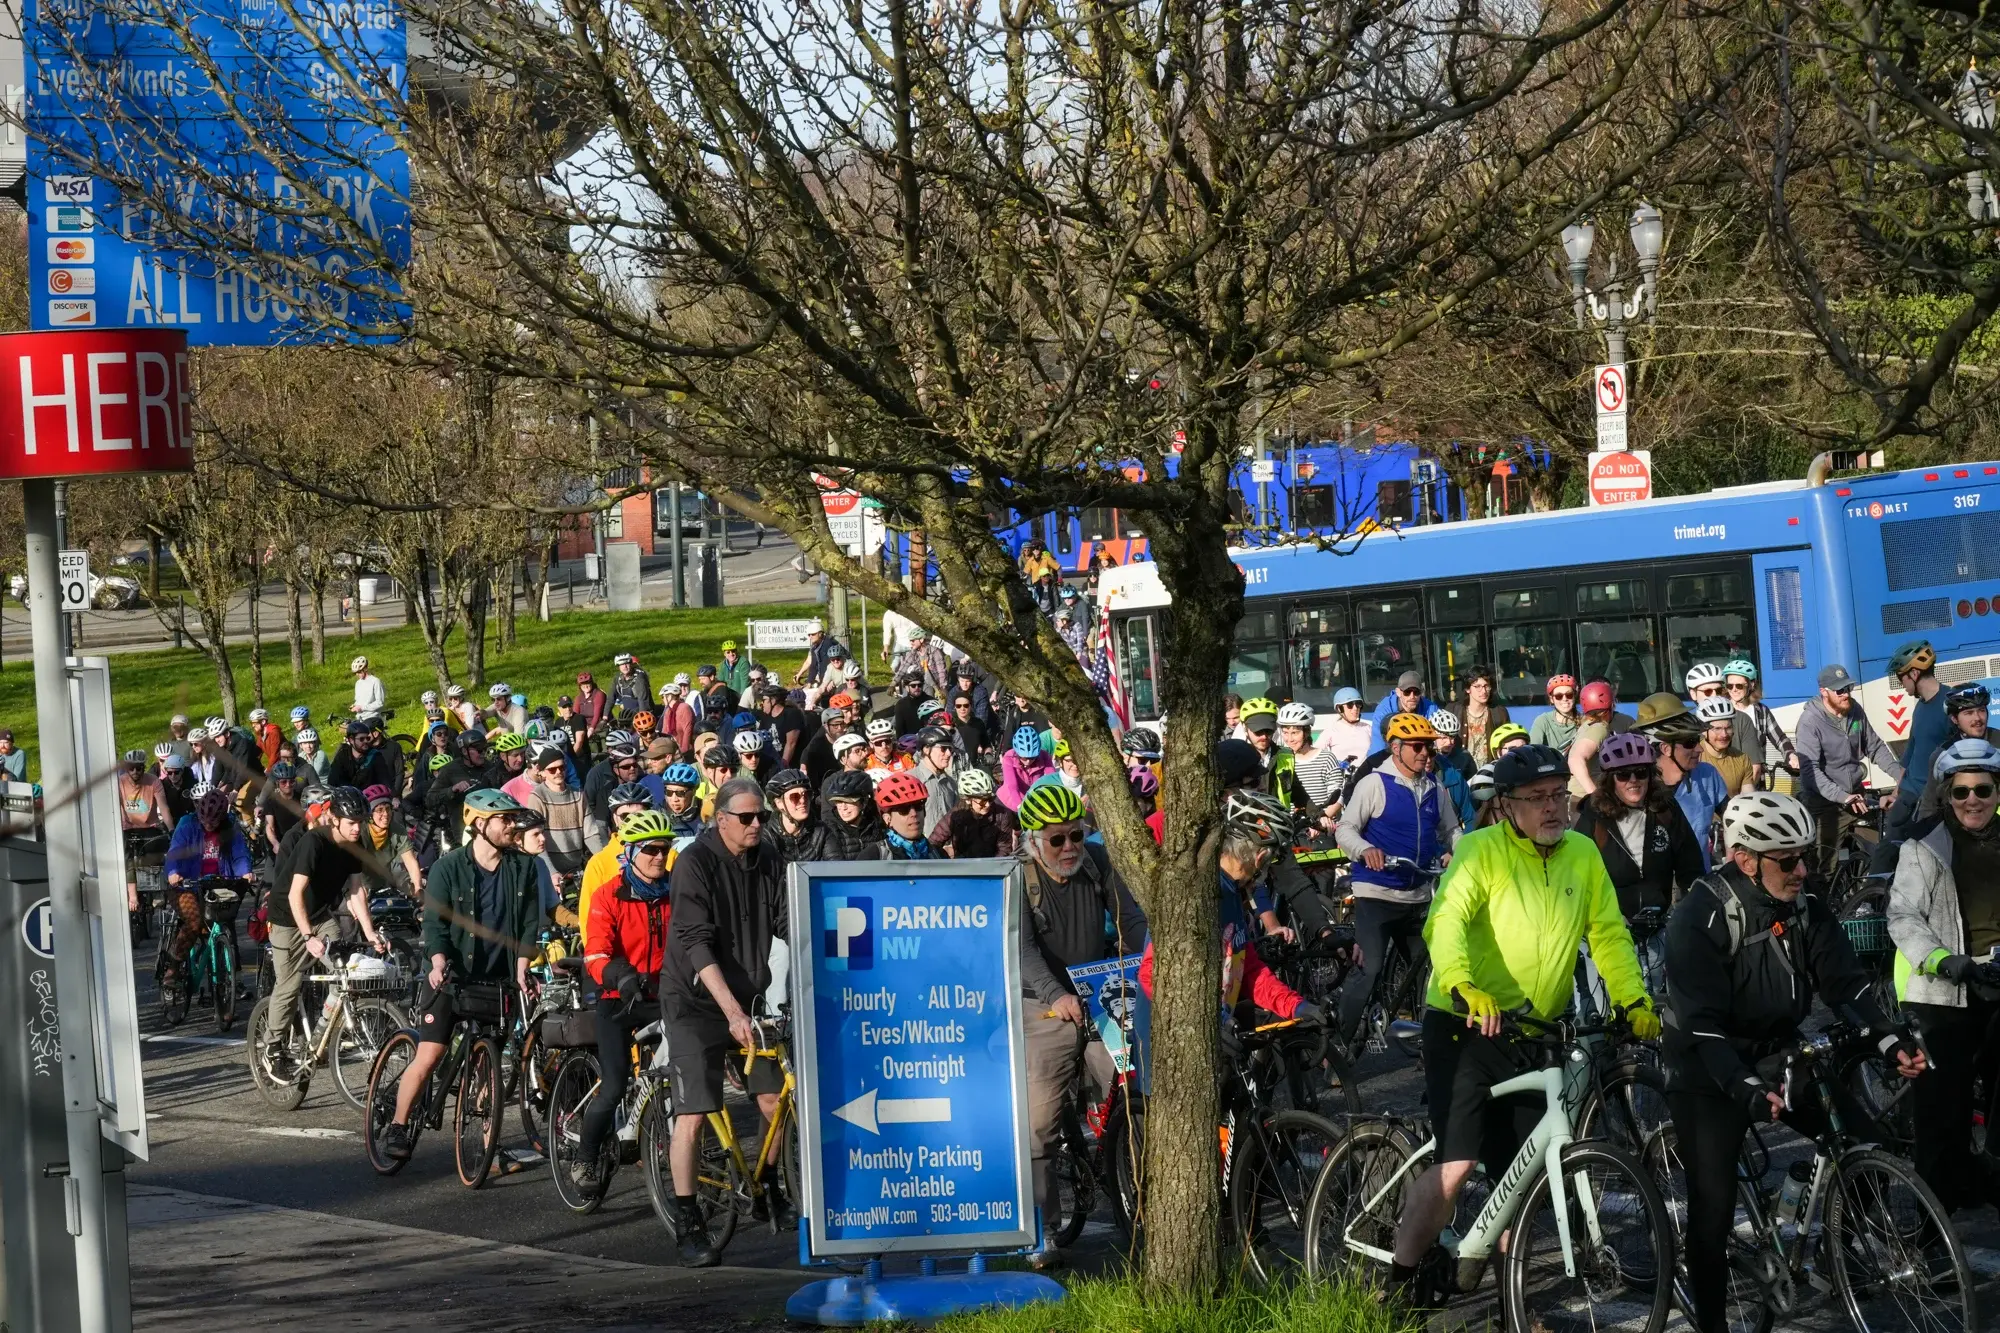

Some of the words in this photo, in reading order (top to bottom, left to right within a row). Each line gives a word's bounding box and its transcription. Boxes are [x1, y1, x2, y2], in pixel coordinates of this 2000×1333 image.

[52, 181, 90, 196] VISA
[126, 255, 201, 324] ALL
[19, 352, 192, 455] HERE
[1599, 465, 1613, 475] DO
[1619, 463, 1640, 474] NOT
[823, 497, 850, 506] ENTER
[1603, 491, 1637, 502] ENTER
[1954, 494, 1981, 508] 3167
[844, 521, 858, 529] BUS
[1673, 523, 1726, 540] trimet.org
[59, 556, 84, 566] EED
[62, 569, 80, 579] MIT
[758, 625, 789, 635] SIDEWALK
[882, 904, 988, 930] PARKING
[881, 936, 921, 961] NW
[1071, 969, 1086, 977] WE
[1087, 965, 1107, 975] RIDE
[1107, 962, 1118, 971] IN
[842, 986, 897, 1017] Hourly
[928, 985, 950, 1009] All
[954, 984, 986, 1015] Day
[861, 1019, 966, 1046] Eves/Wknds
[882, 1053, 966, 1084] Overnight
[849, 1146, 914, 1174] Monthly
[918, 1144, 982, 1171] Parking
[880, 1174, 956, 1199] Available
[1475, 1137, 1537, 1240] SPECIALIZED
[826, 1206, 918, 1231] ParkingNW.com
[930, 1201, 1013, 1223] 503-800-1003
